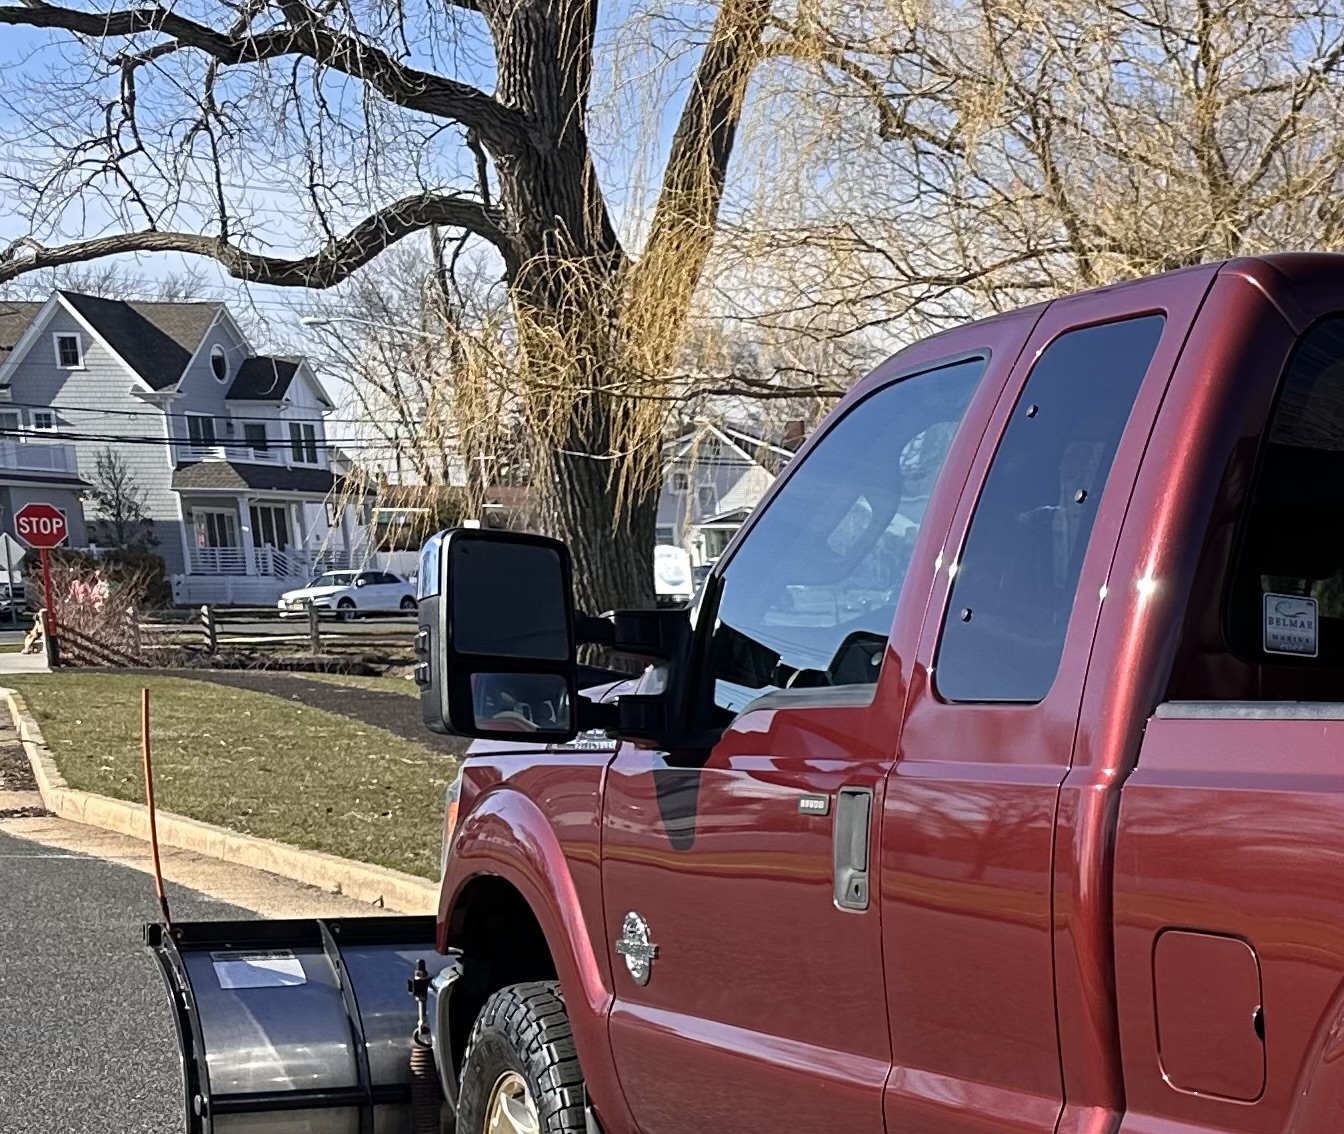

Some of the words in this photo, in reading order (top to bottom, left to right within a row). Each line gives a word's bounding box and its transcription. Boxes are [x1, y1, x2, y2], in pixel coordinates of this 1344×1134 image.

[18, 516, 64, 535] STOP
[1268, 616, 1313, 629] BELMAR
[1271, 633, 1310, 643] MARINA
